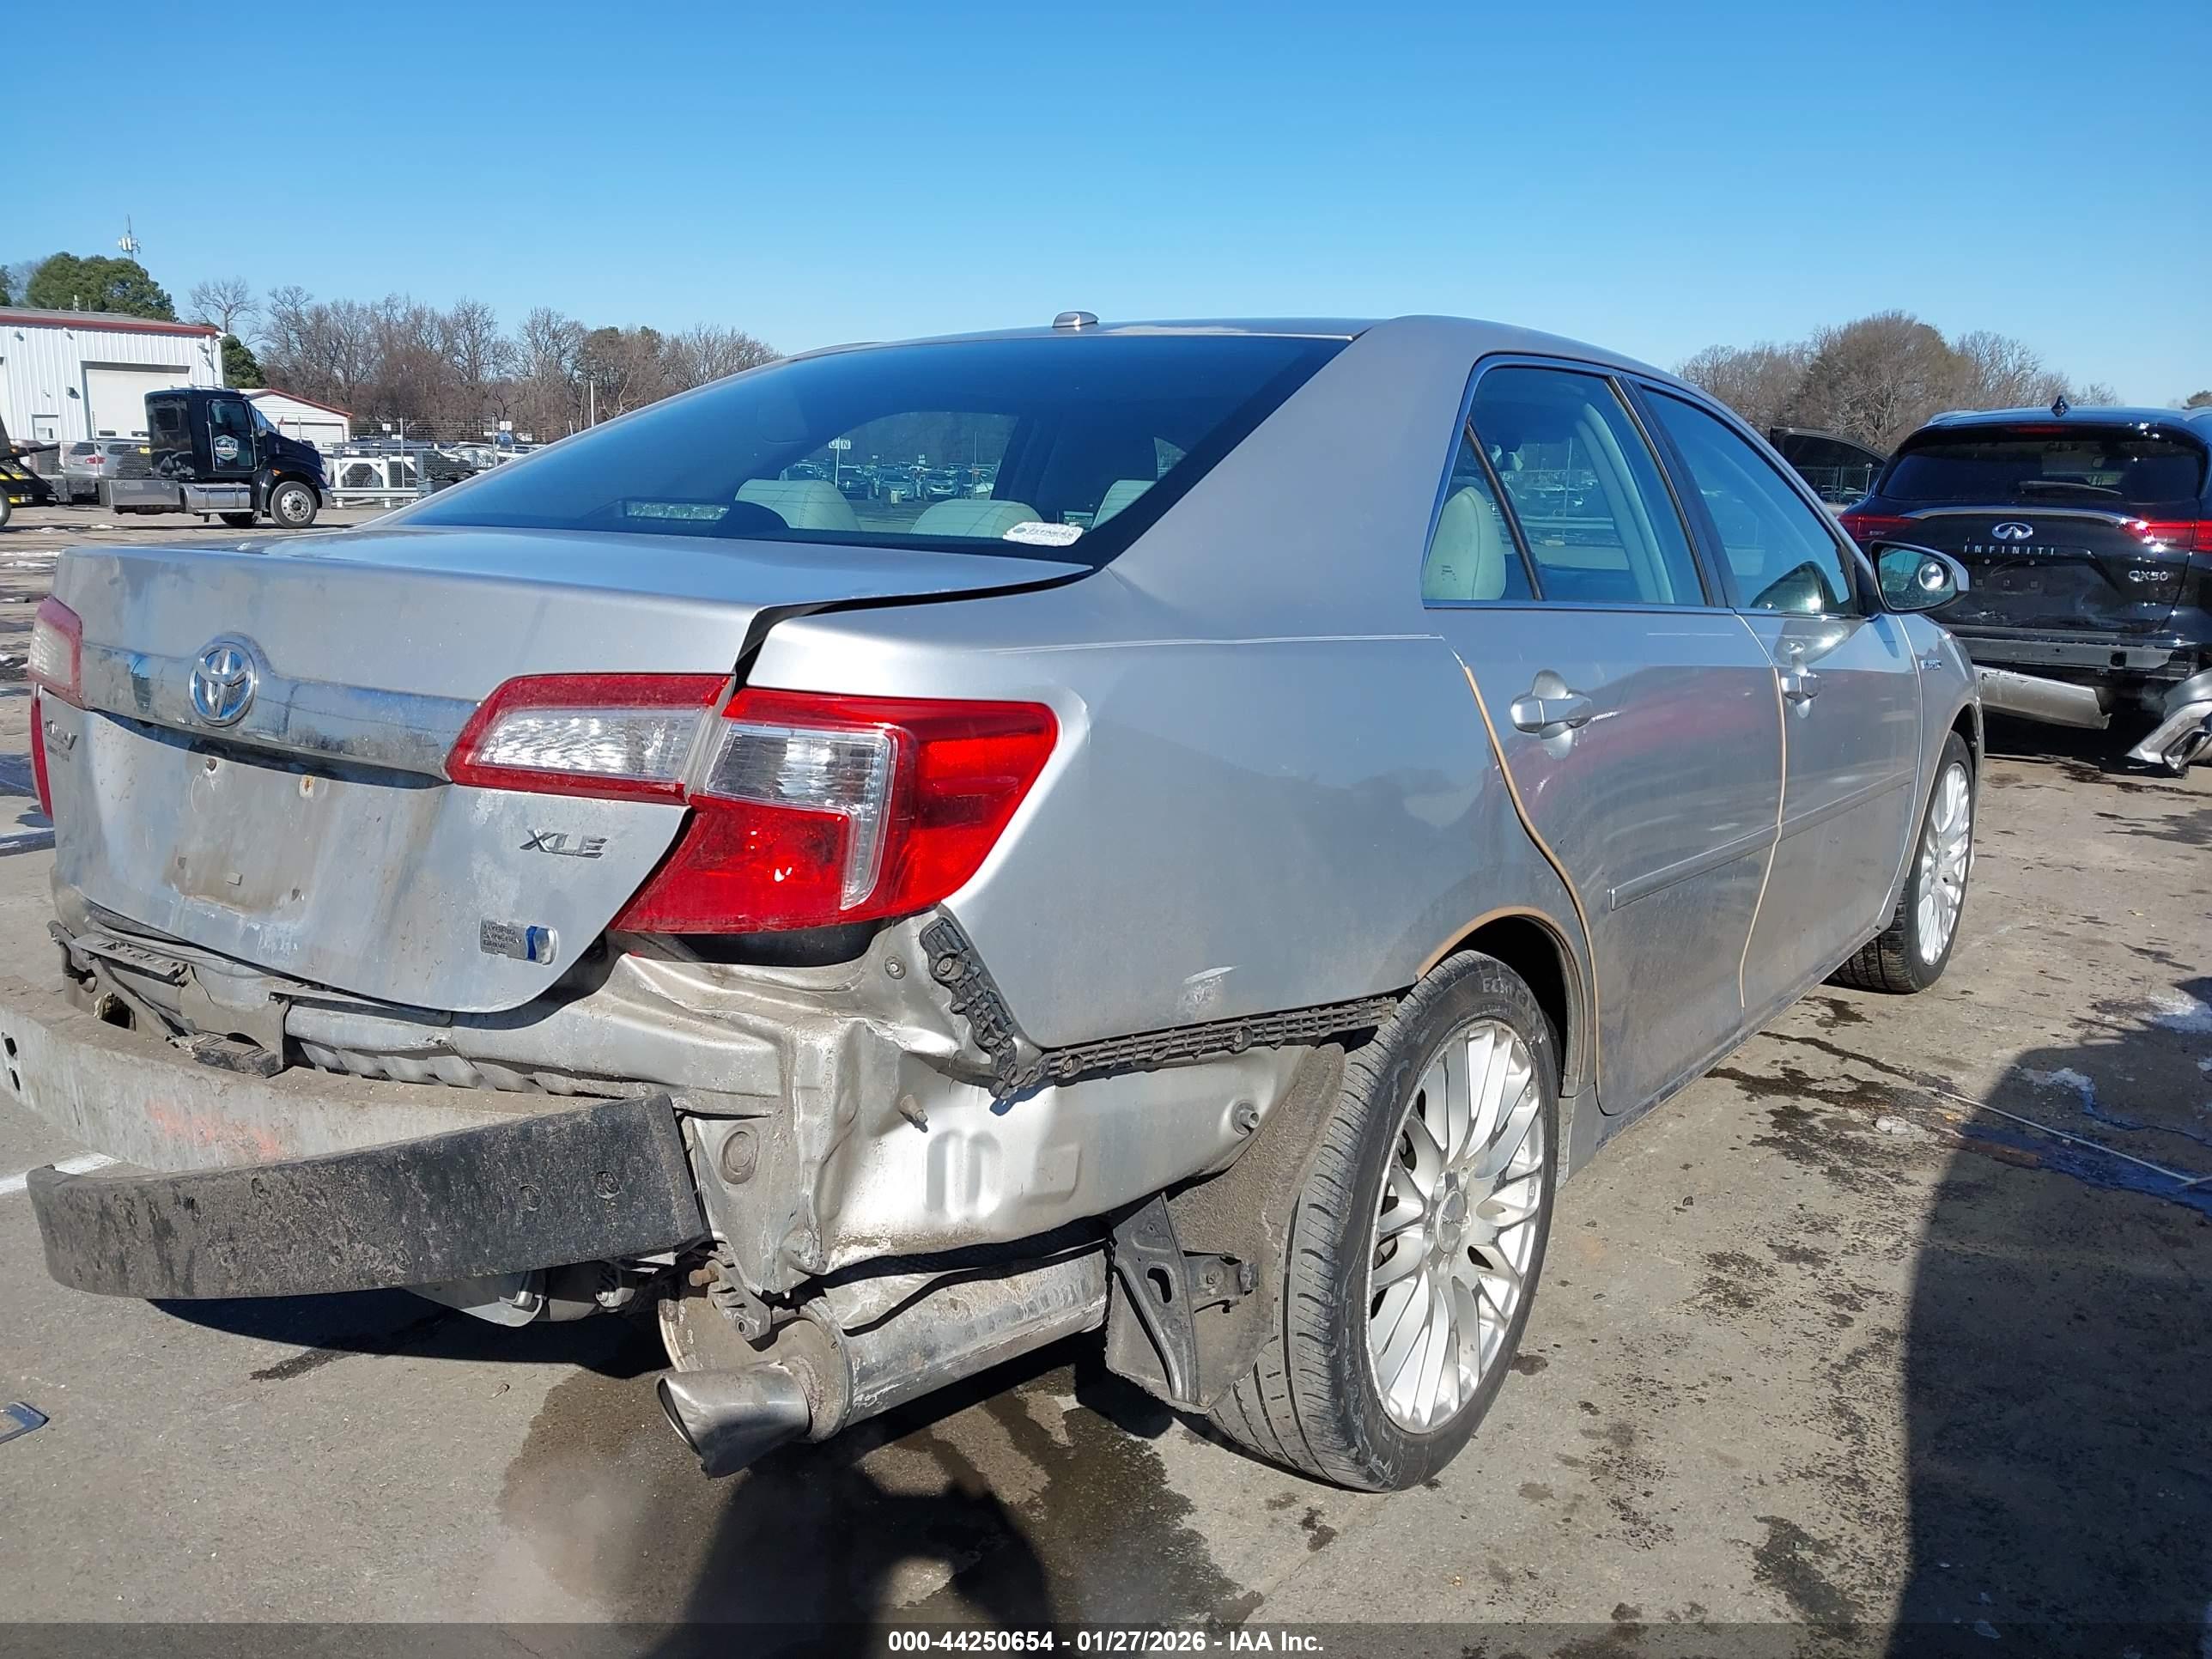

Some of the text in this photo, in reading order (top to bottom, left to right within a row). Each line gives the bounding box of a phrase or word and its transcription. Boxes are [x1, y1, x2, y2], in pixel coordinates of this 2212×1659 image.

[1964, 544, 2055, 556] INFINITI
[2129, 570, 2168, 583] QX50
[519, 829, 610, 859] XLE
[483, 923, 515, 935] HYBRID
[483, 931, 522, 944] SYNERGY
[483, 939, 508, 949] DRIVE
